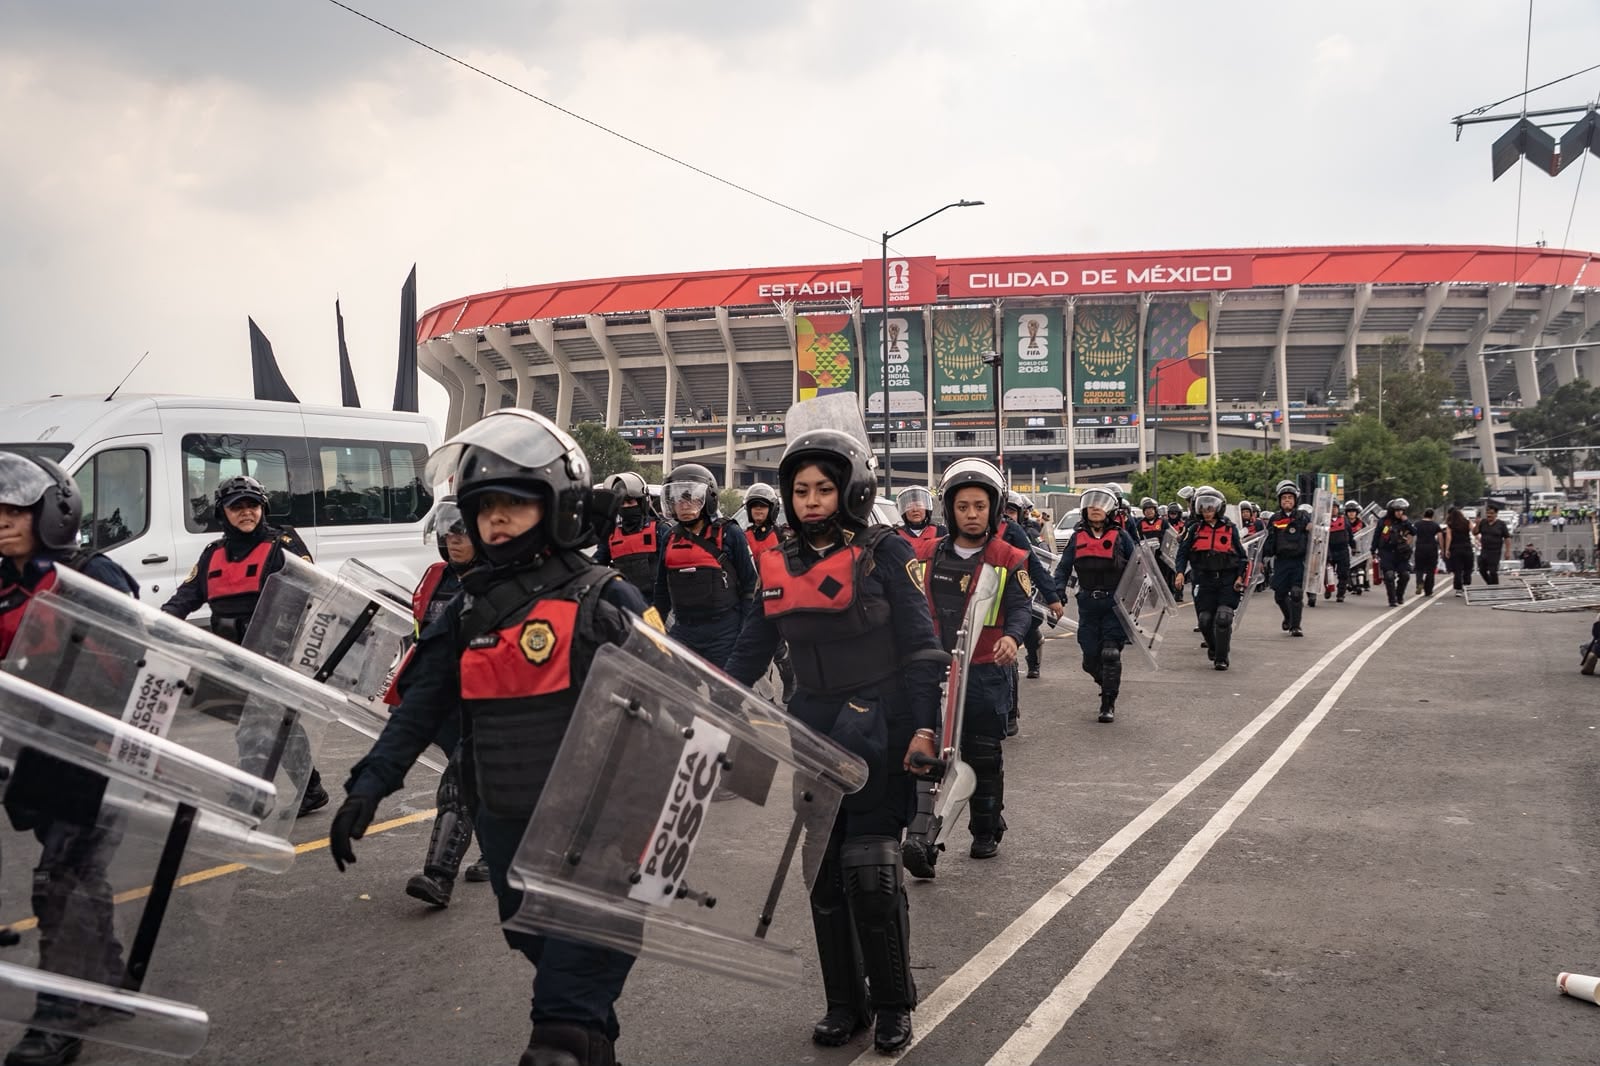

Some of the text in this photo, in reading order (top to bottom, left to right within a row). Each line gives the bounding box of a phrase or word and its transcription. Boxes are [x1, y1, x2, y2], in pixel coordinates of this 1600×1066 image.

[758, 281, 851, 297] ESTADIO
[969, 264, 1232, 288] CIUDAD DE MÉXICO
[1084, 381, 1126, 390] SOMOS
[299, 612, 334, 669] POLICIA
[645, 751, 700, 877] POLICÍA
[661, 754, 718, 884] SSC
